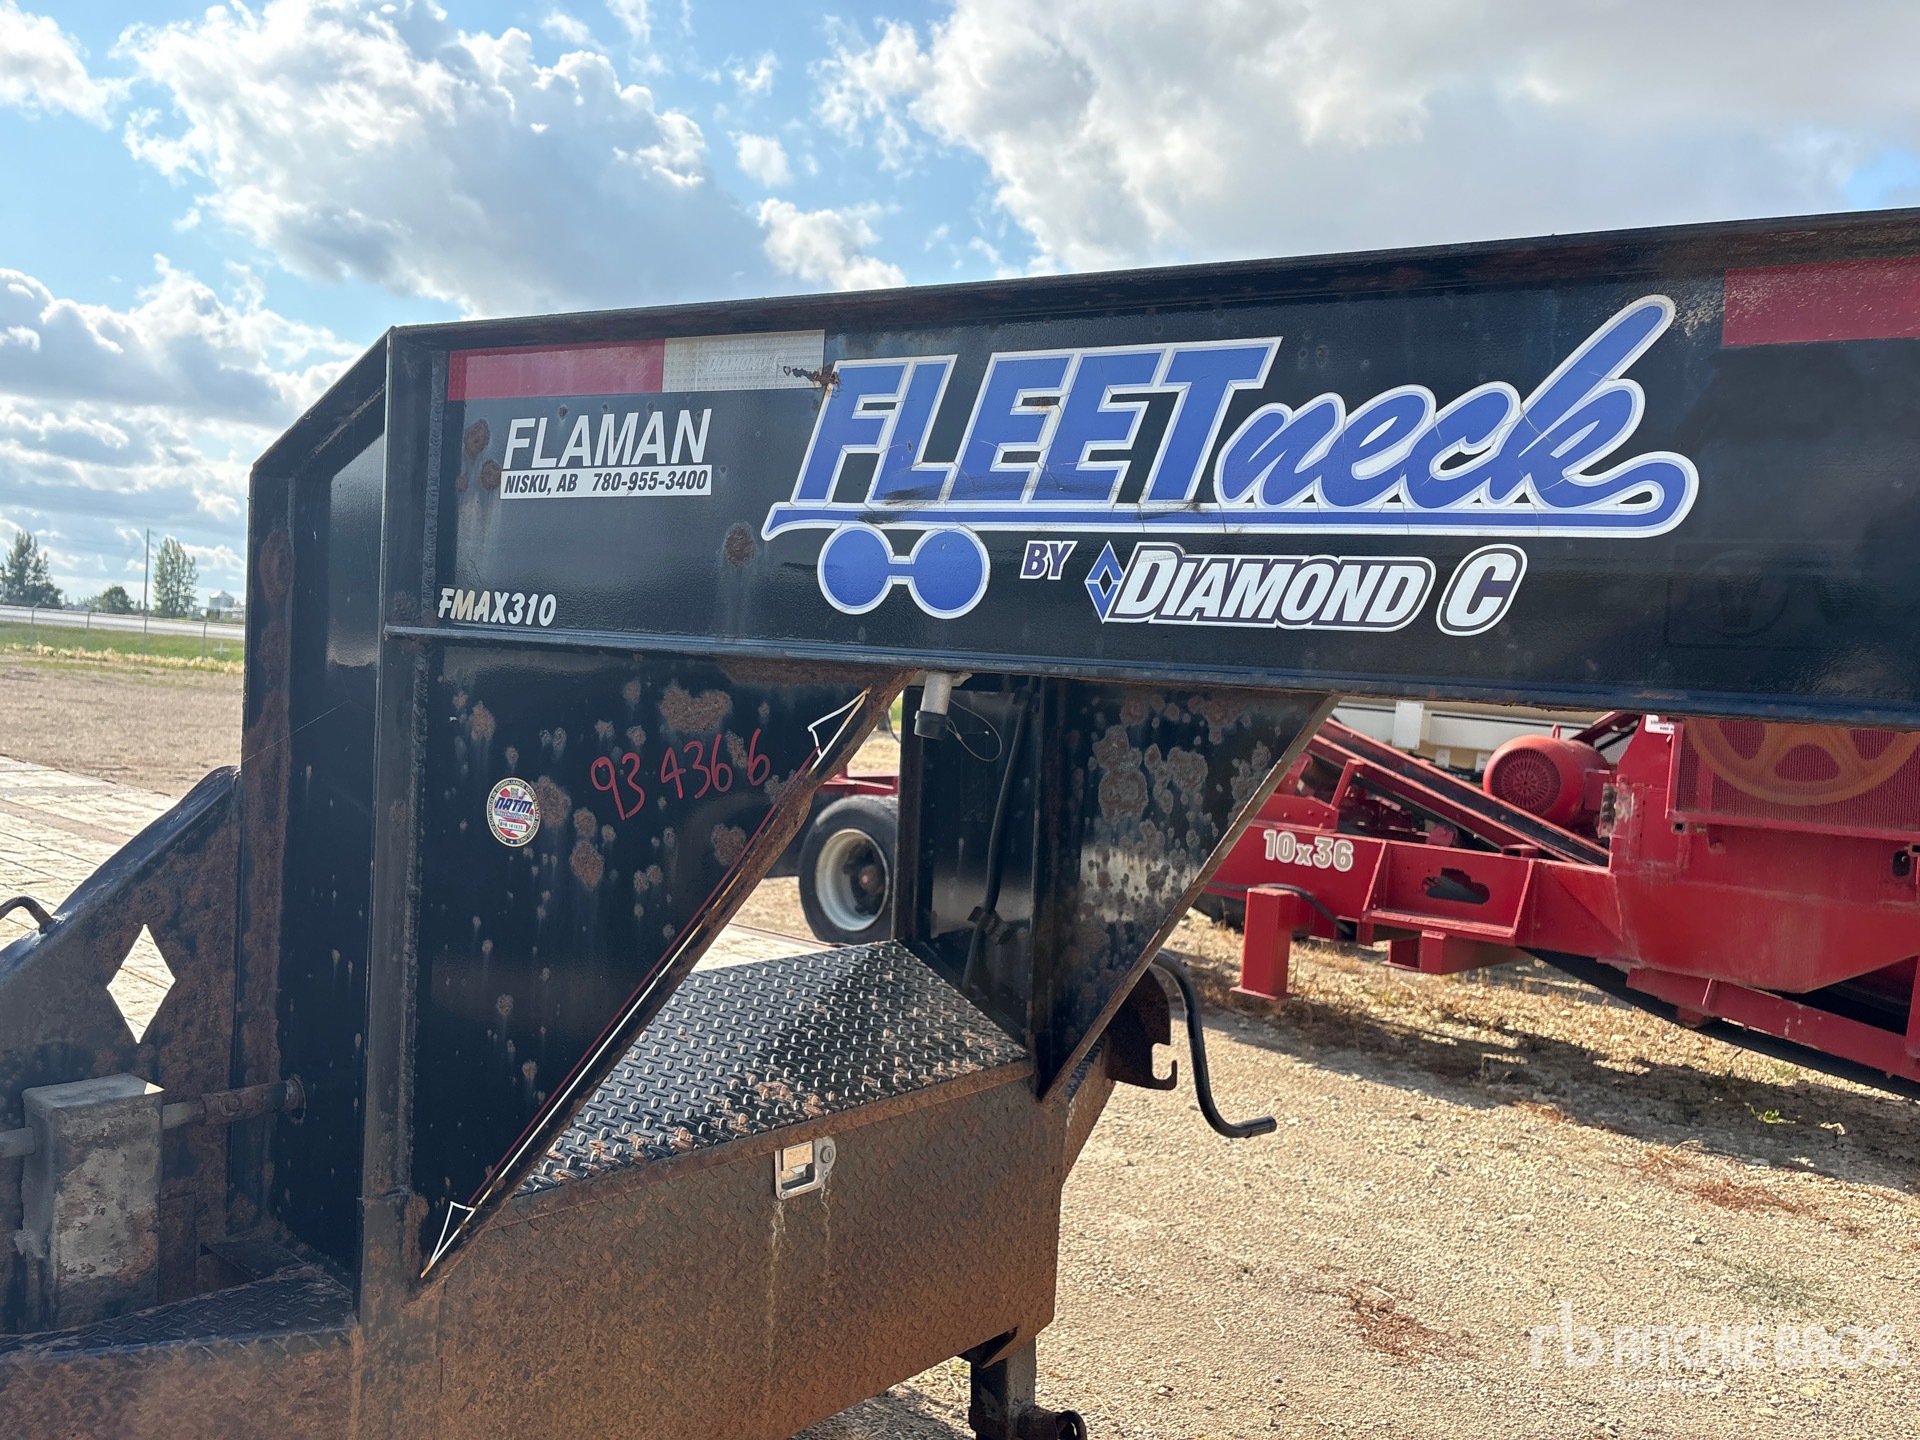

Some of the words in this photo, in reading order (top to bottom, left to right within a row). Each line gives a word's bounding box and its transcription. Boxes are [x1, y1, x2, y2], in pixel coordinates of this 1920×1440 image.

[502, 408, 712, 470] FLAMAN
[504, 474, 552, 495] NISKU,
[556, 473, 579, 492] AB
[592, 470, 708, 492] 780-955-3400
[438, 588, 557, 627] FMAX310
[1019, 540, 1078, 579] BY
[1108, 543, 1435, 631] DIAMOND
[1438, 545, 1527, 635] C
[495, 797, 533, 814] NATM
[1263, 829, 1354, 872] 10x36
